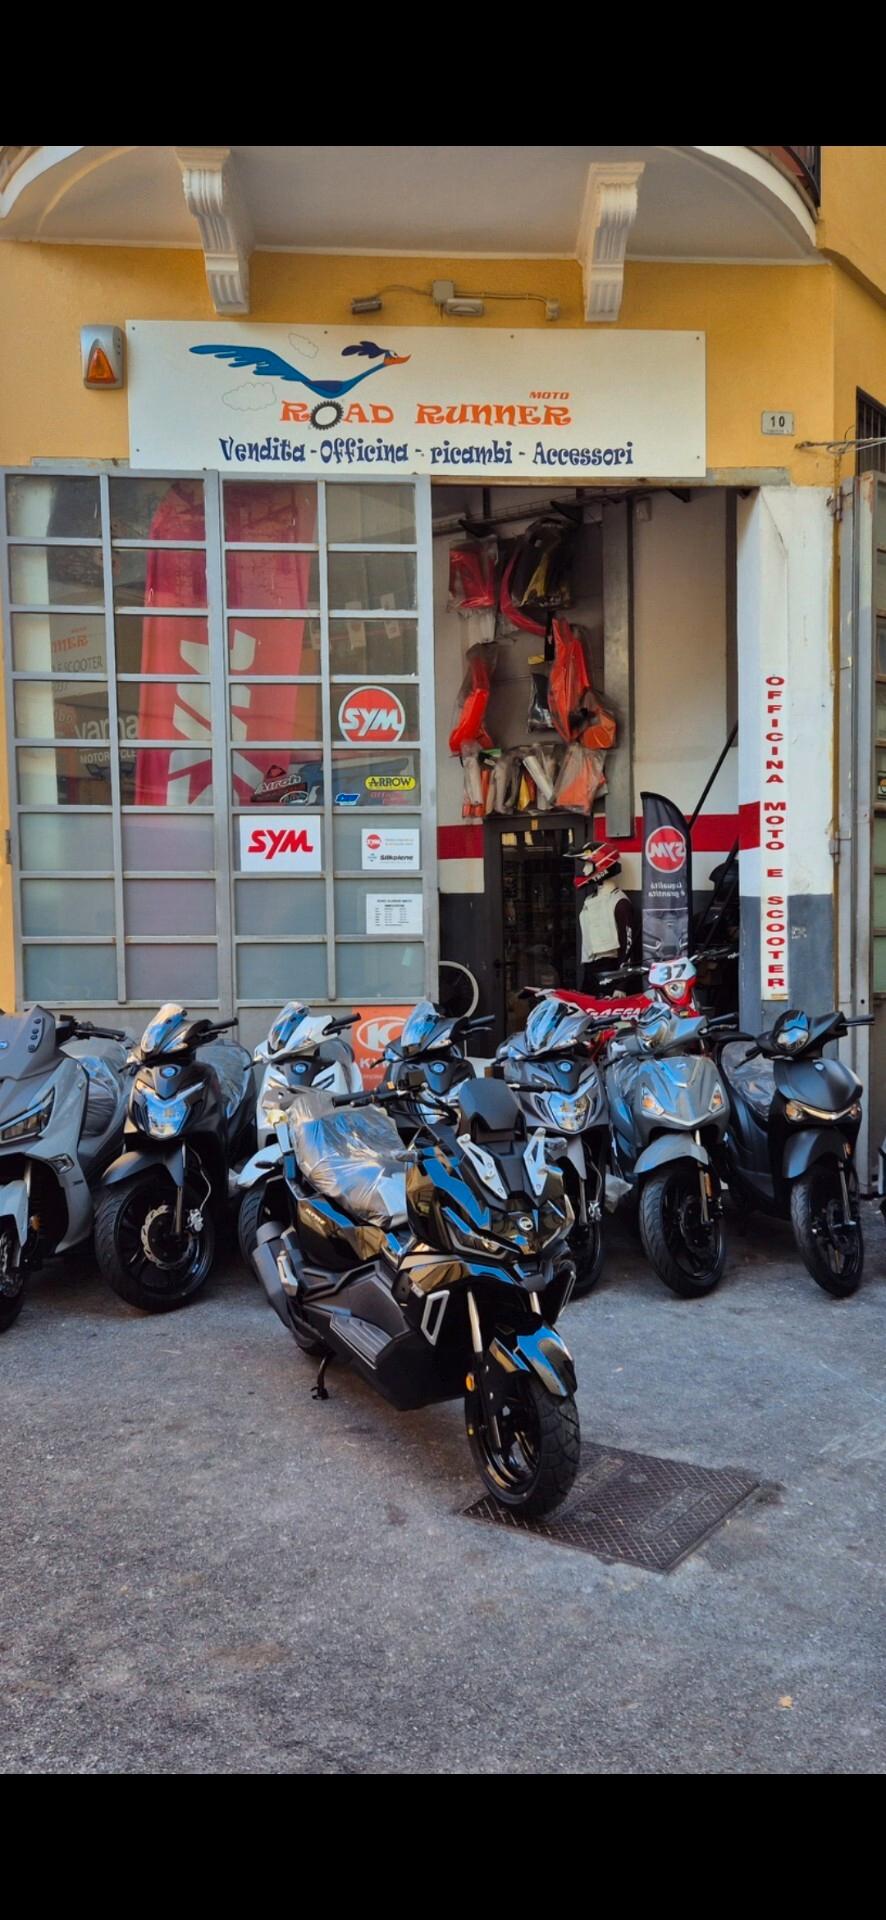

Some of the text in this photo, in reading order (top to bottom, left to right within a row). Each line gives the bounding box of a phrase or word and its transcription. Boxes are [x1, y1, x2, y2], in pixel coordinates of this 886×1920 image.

[529, 391, 570, 400] MOTO
[280, 400, 572, 431] ROAD RUNNER
[770, 415, 786, 427] 10
[219, 436, 306, 462] Vendita
[320, 438, 409, 464] Officina
[430, 440, 513, 465] ricambi
[532, 441, 634, 466] Accessori
[340, 707, 405, 737] SYM
[369, 776, 412, 787] ARROW
[248, 829, 314, 860] SYM
[764, 676, 786, 987] OFFICINA MOTO E SCOOTER
[662, 963, 687, 981] 37
